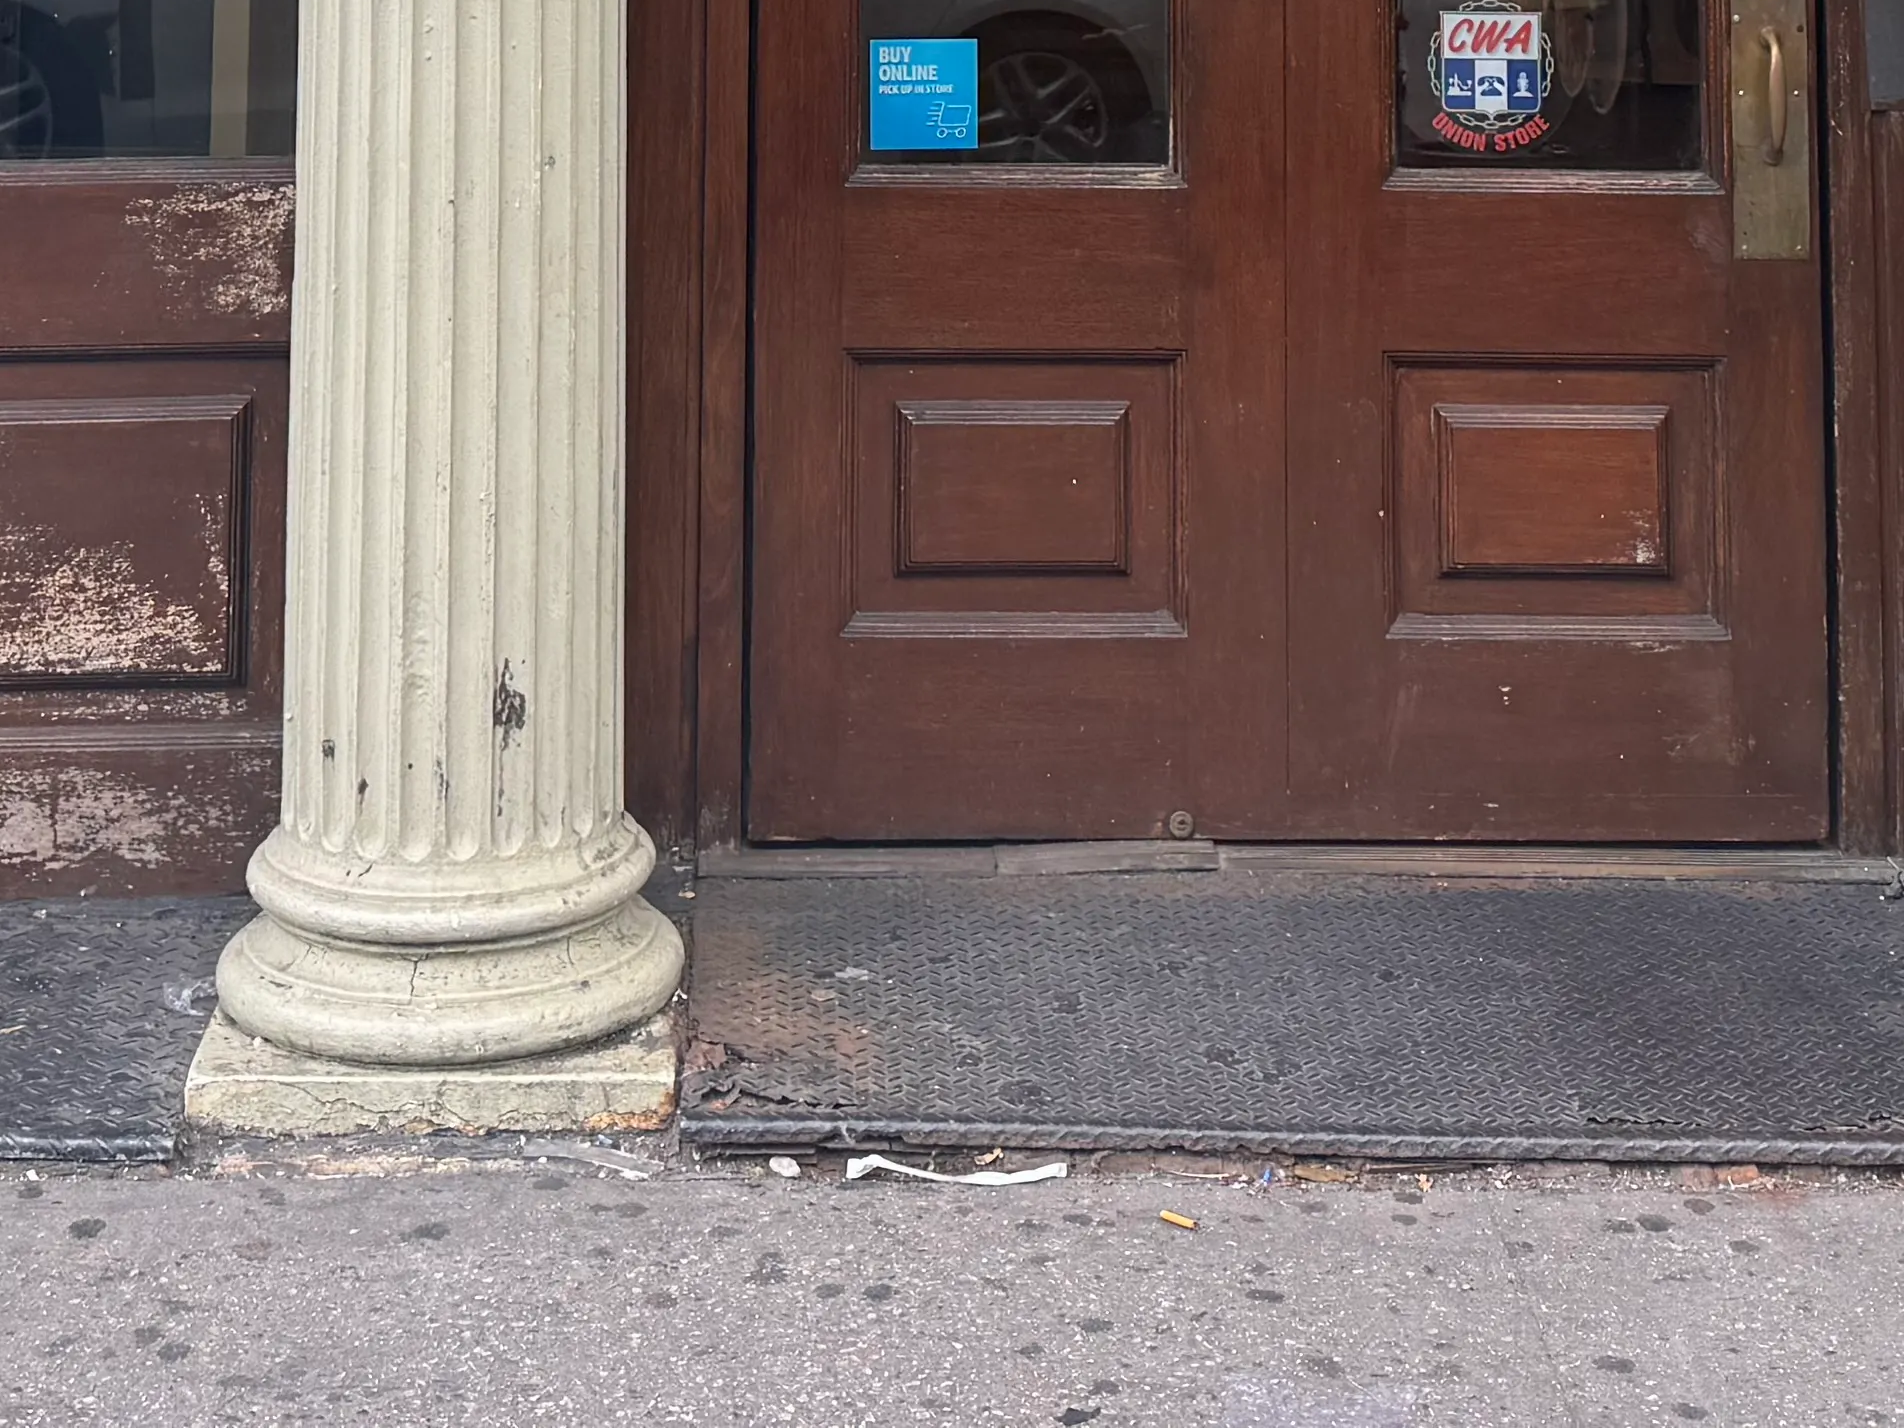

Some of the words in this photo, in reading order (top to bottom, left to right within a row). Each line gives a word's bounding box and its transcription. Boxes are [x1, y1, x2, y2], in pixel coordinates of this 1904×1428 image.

[1448, 18, 1533, 54] CWA
[879, 46, 913, 63] BUY
[879, 64, 939, 81] ONLINE
[879, 84, 899, 94] PICK
[900, 84, 913, 94] UP
[1432, 111, 1487, 152] UNION
[1494, 113, 1550, 152] STORE
